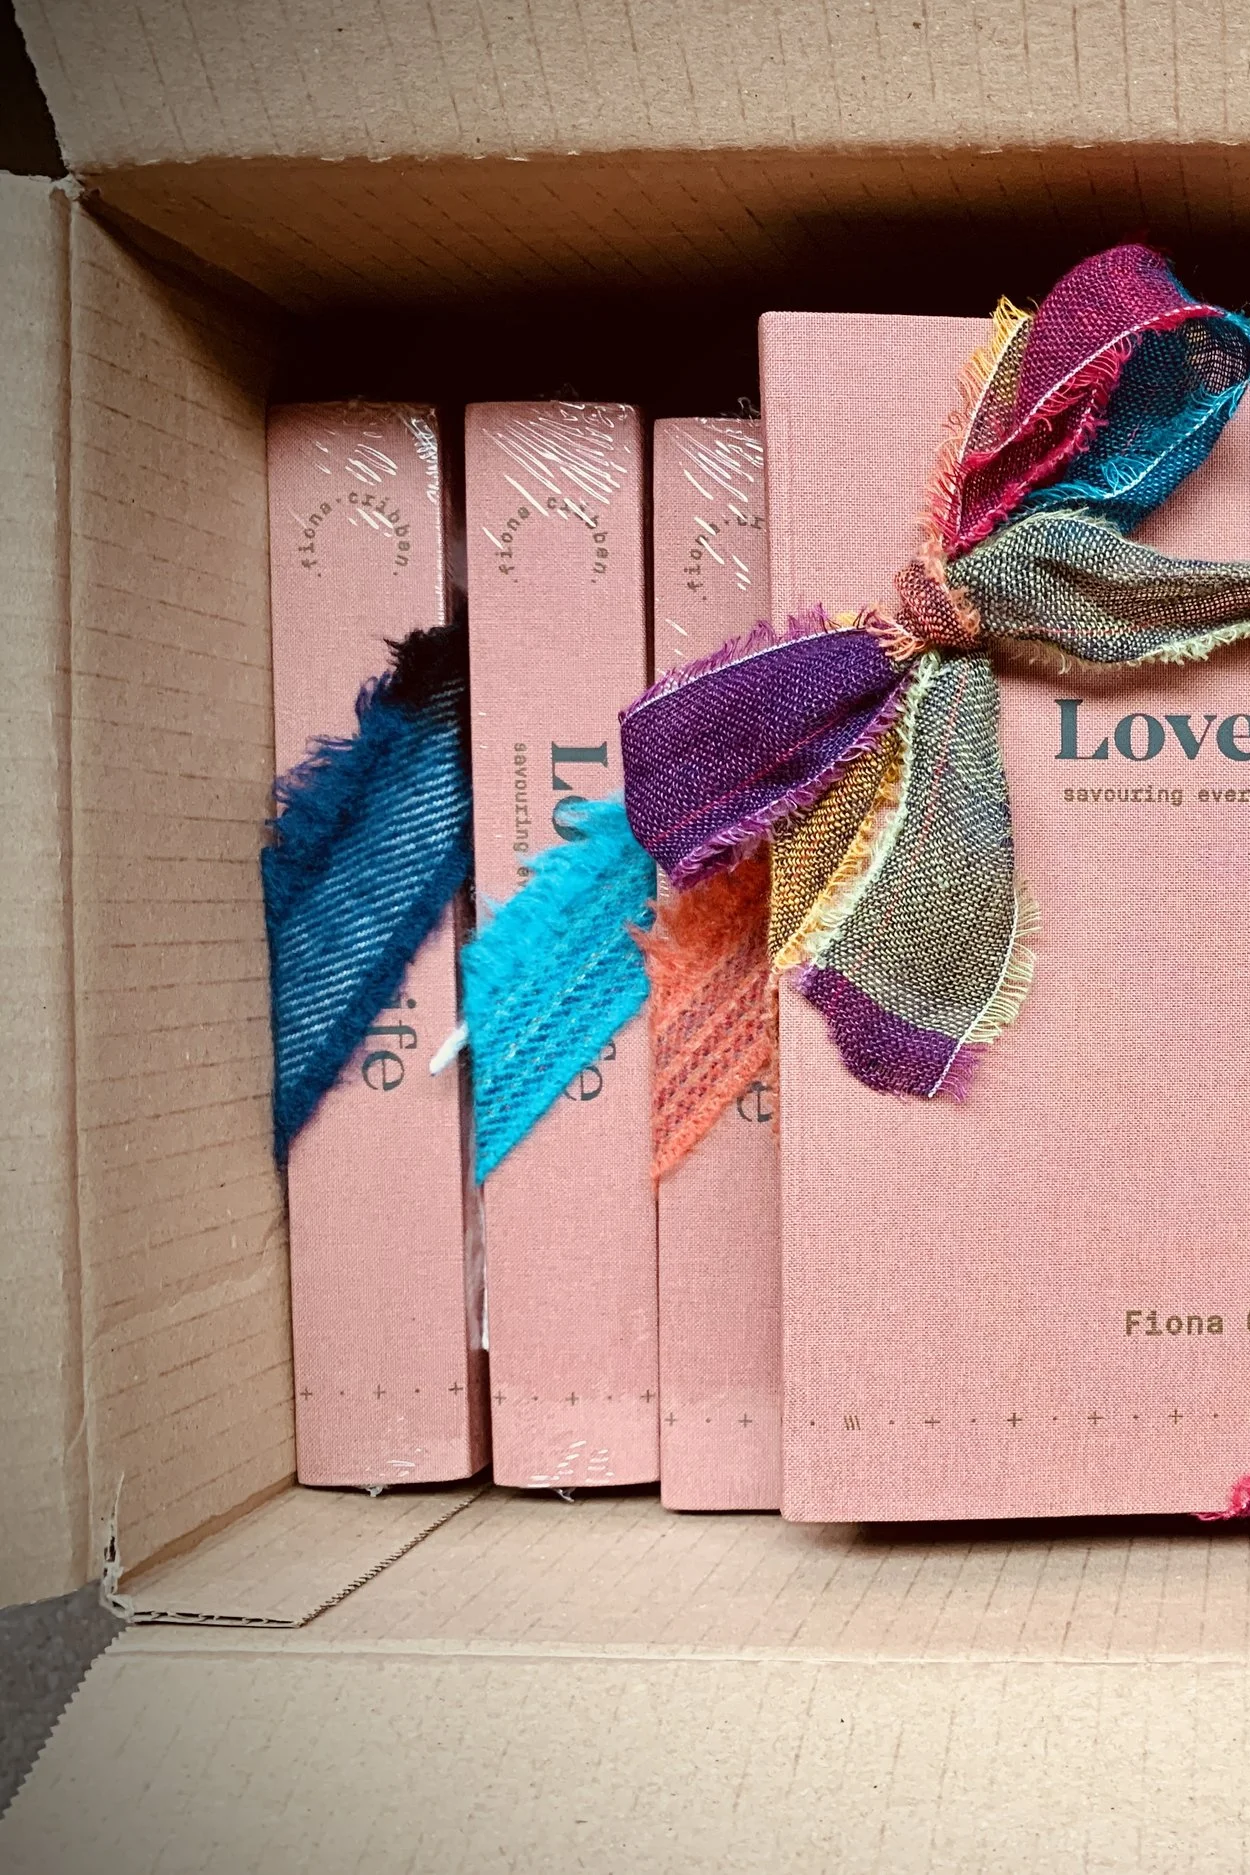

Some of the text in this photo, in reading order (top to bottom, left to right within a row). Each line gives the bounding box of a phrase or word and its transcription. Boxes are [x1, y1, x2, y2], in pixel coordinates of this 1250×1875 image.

[513, 742, 532, 853] savouring
[1063, 786, 1184, 807] savouring
[361, 997, 417, 1092] ife
[1125, 1309, 1225, 1336] Fiona
